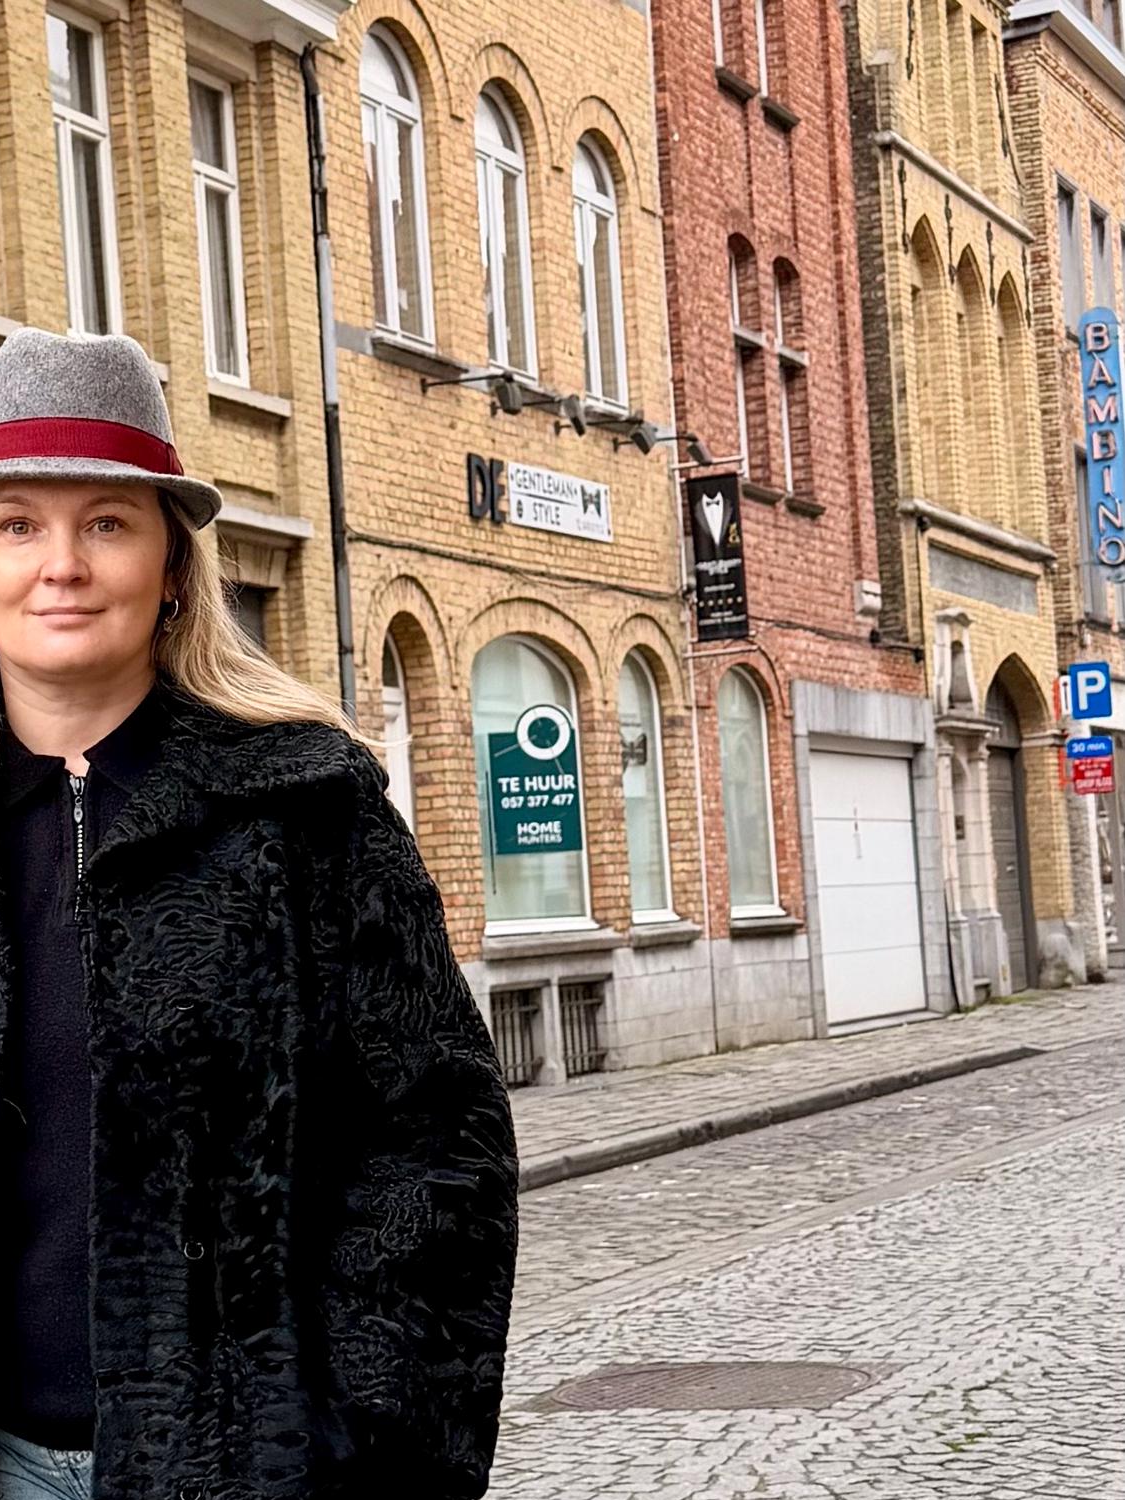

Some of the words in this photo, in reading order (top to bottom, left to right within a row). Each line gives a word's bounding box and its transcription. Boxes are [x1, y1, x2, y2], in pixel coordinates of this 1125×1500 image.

[1086, 323, 1125, 565] BAMBINO
[466, 453, 505, 523] DE
[515, 469, 574, 498] GENTLEMAN
[532, 502, 561, 527] STYLE
[1077, 670, 1106, 711] P
[498, 777, 520, 793] TE
[525, 775, 575, 791] HUUR
[501, 797, 523, 809] 057
[527, 795, 548, 807] 377
[551, 793, 574, 806] 477
[517, 821, 561, 834] HOME
[518, 833, 562, 845] HUNTERS
